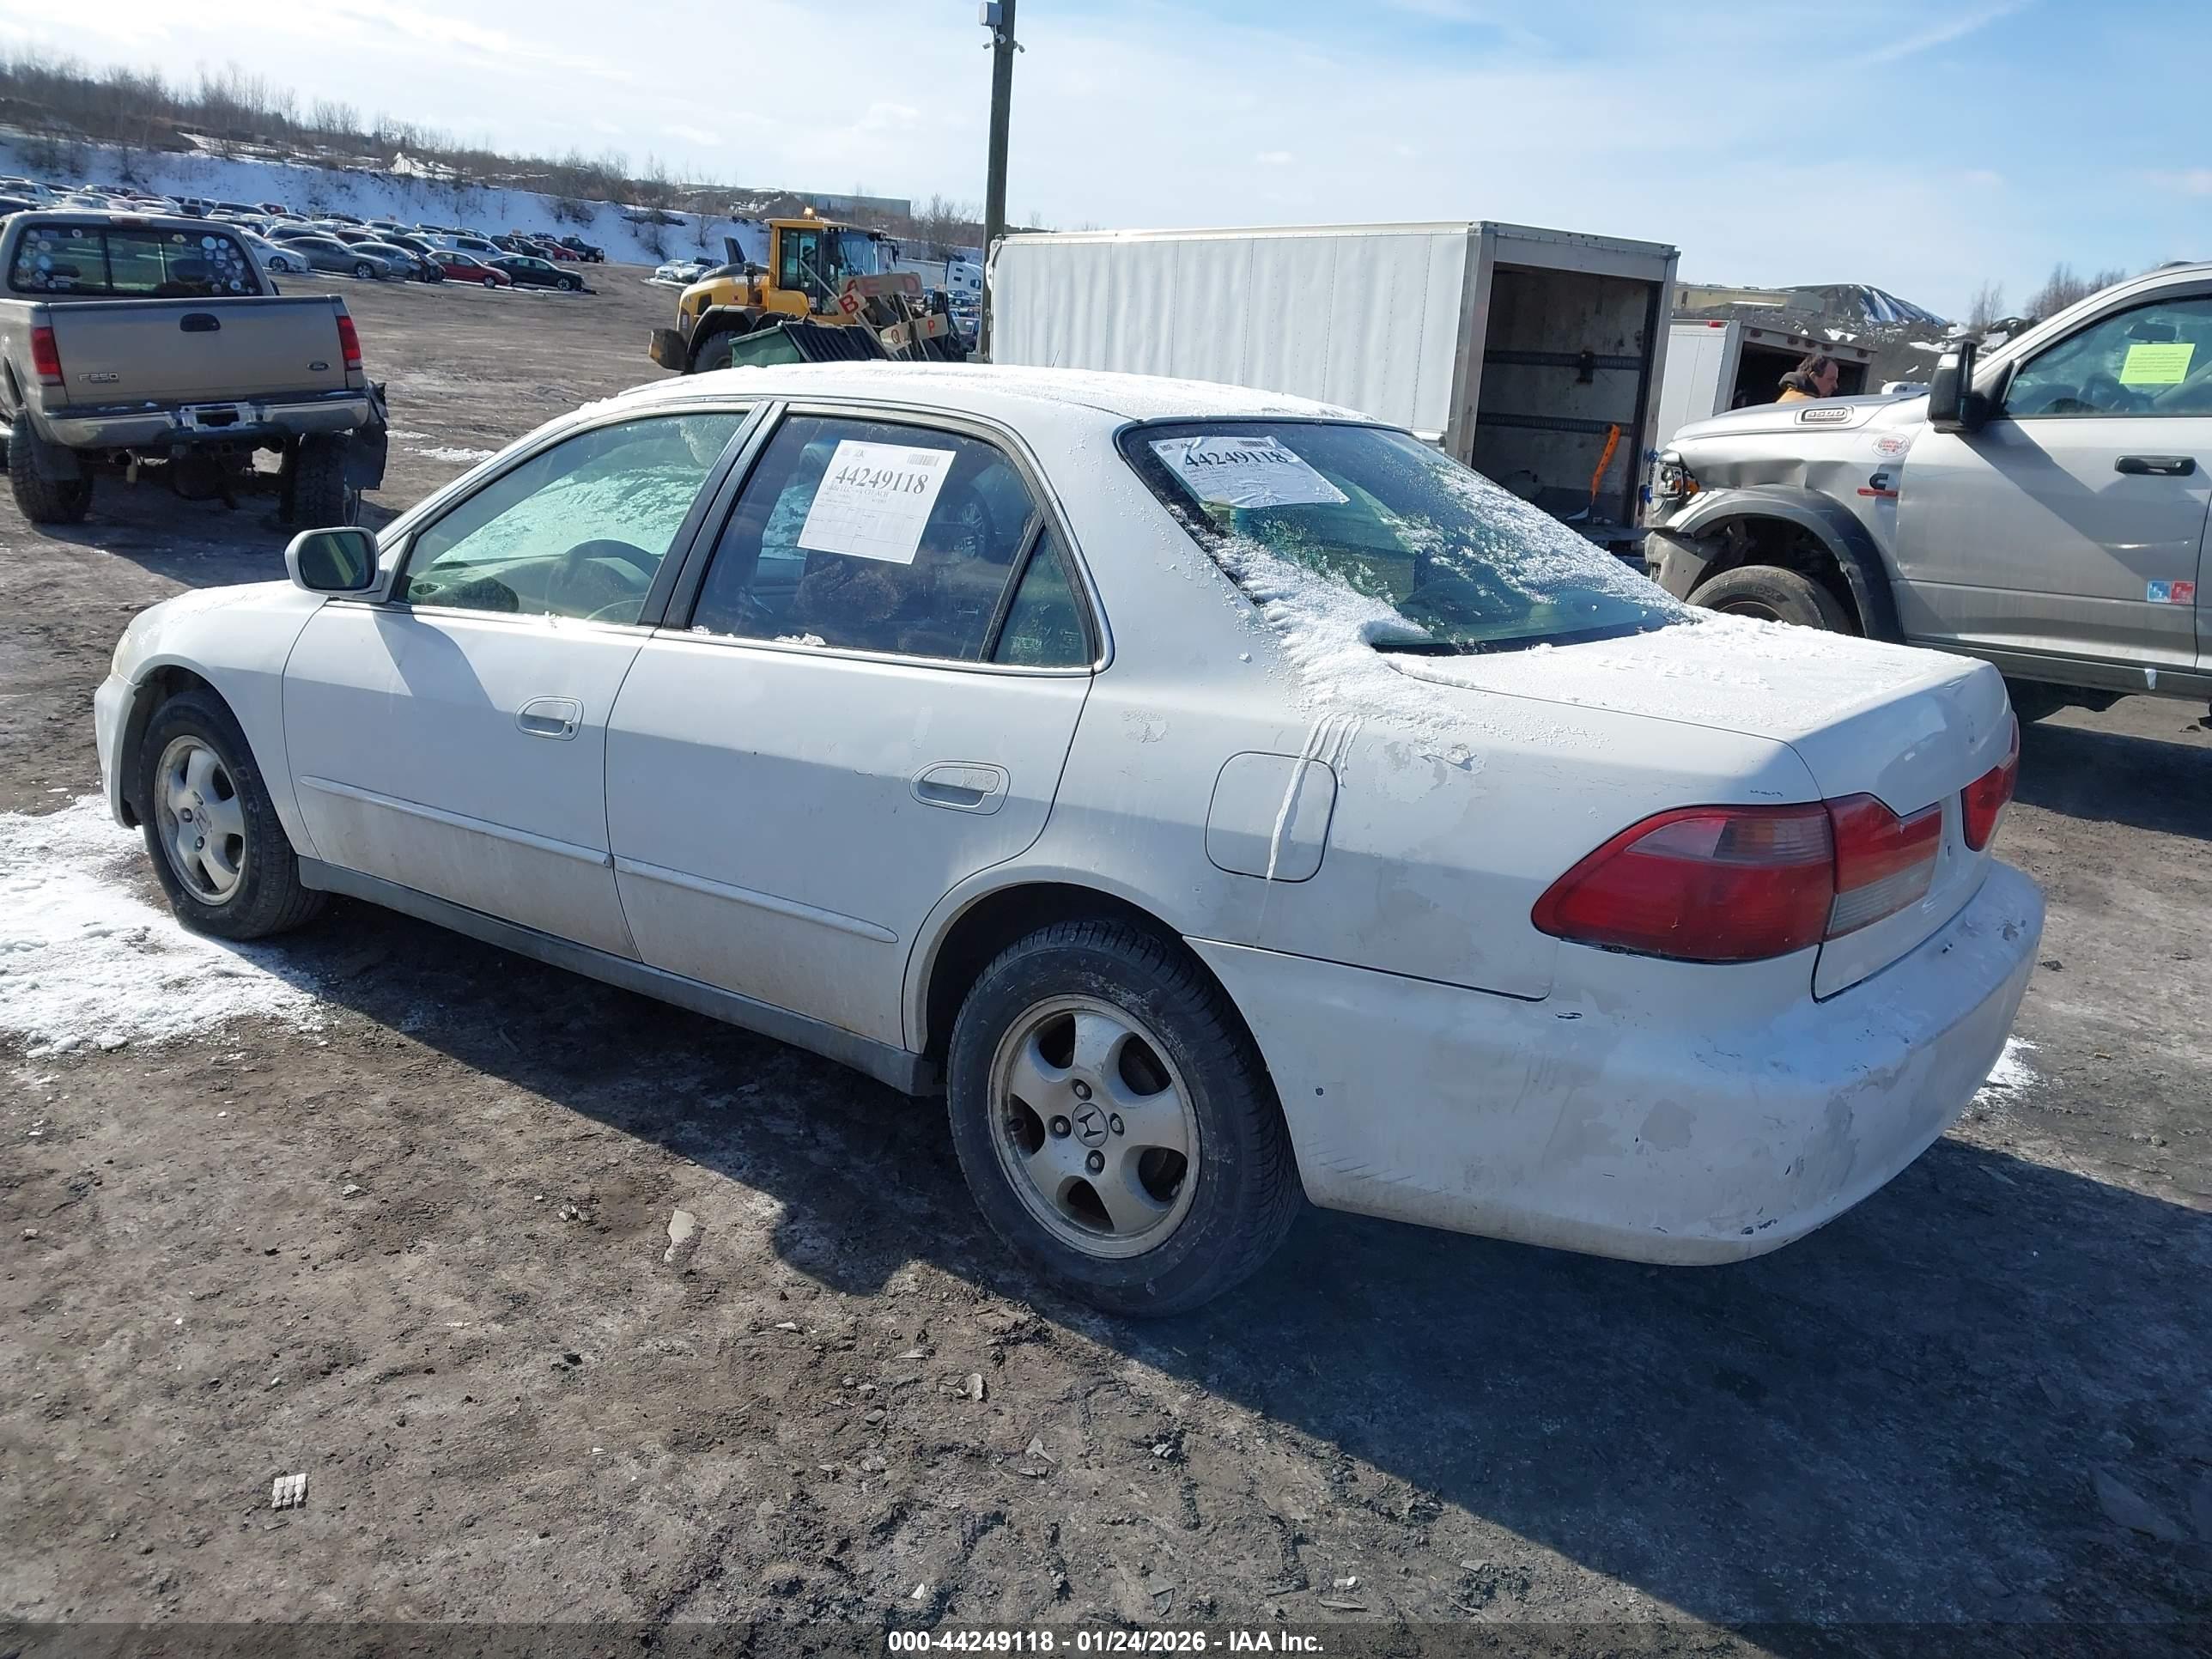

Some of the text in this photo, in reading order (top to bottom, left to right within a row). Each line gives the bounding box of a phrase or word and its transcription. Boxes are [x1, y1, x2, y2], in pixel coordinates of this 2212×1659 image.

[838, 294, 859, 314] B
[927, 319, 935, 336] P
[890, 329, 902, 344] Q
[1185, 451, 1289, 467] 44249118
[836, 465, 929, 495] 44249118
